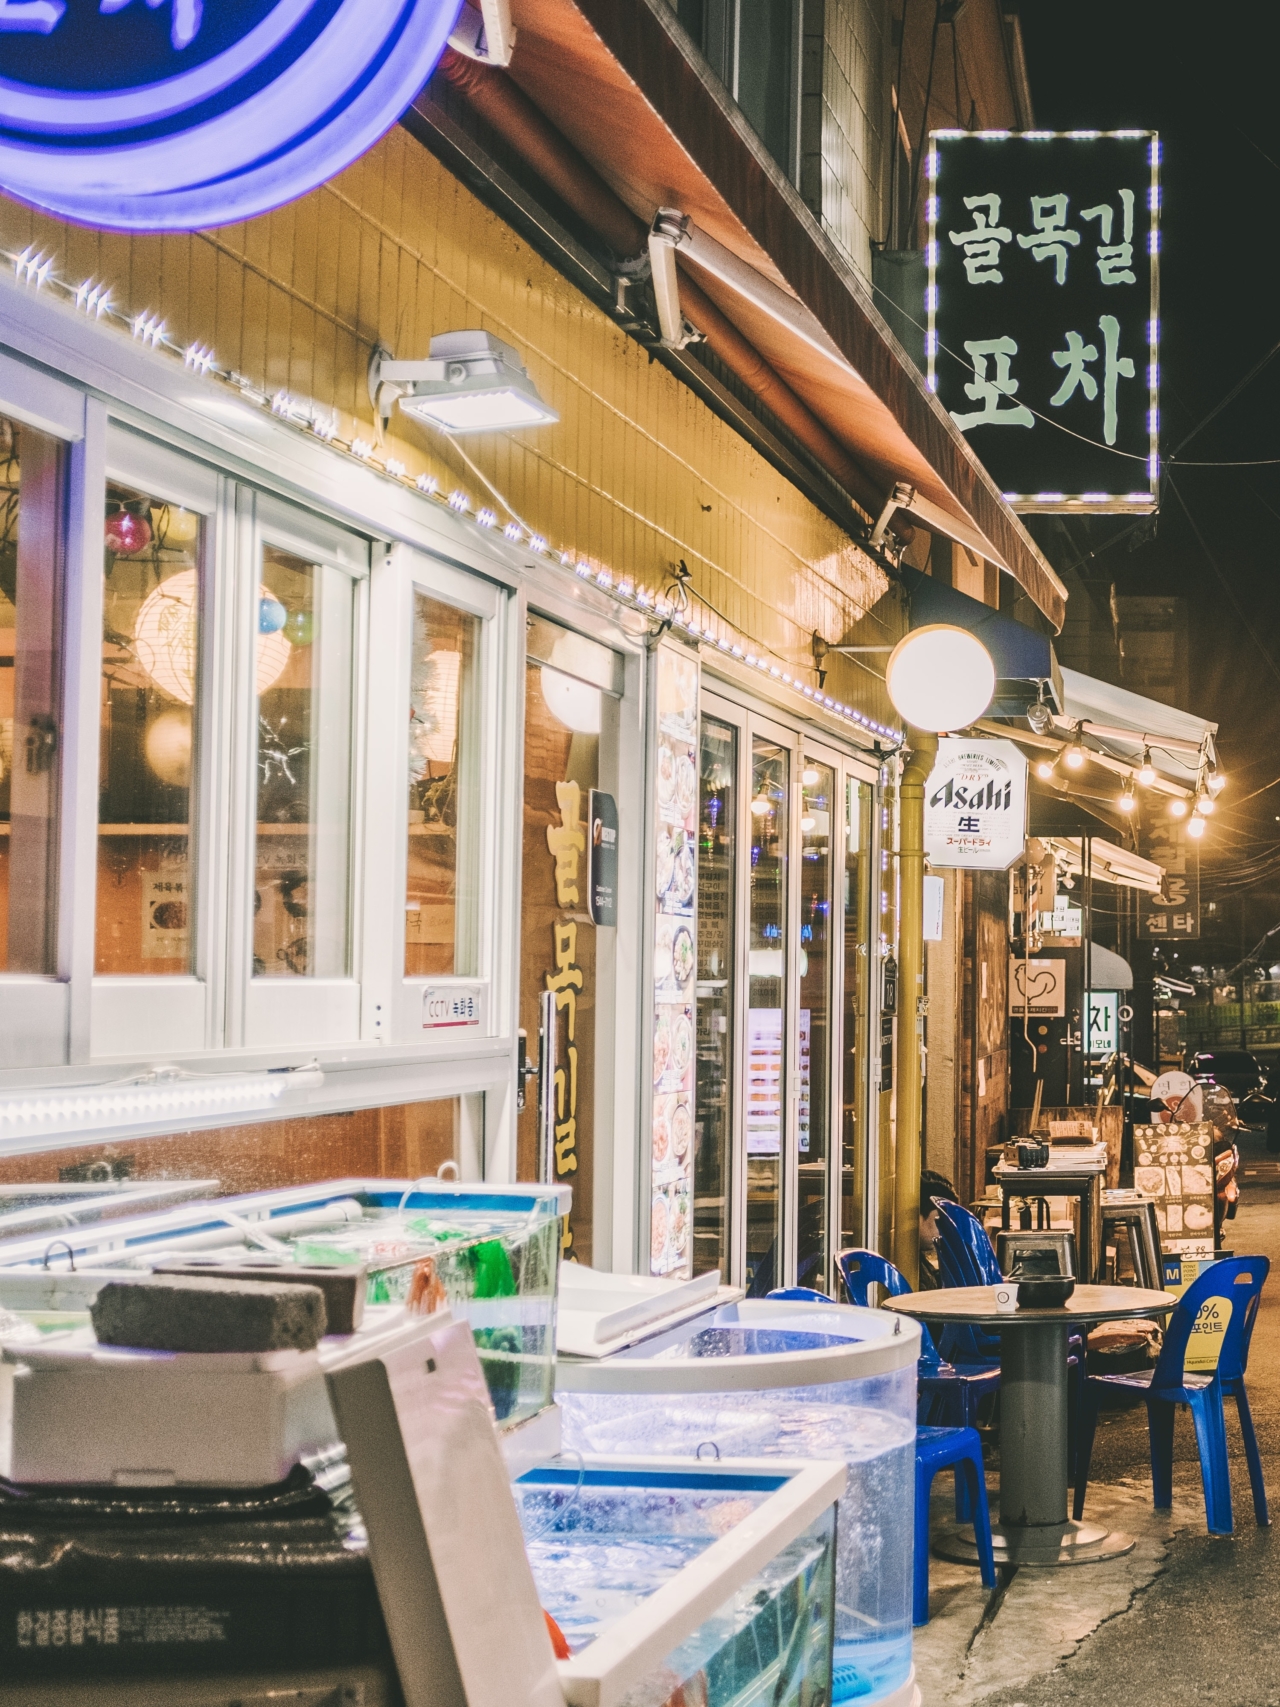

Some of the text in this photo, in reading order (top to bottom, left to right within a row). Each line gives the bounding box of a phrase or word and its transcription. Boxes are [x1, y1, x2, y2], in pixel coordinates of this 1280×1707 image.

[949, 188, 1137, 285] 골목길
[948, 315, 1135, 445] 포차
[930, 777, 1012, 811] Asahi
[958, 815, 980, 833] 生
[946, 837, 992, 847] スーパードライ
[1146, 912, 1194, 932] 센타
[428, 997, 474, 1017] CCTV 녹화중
[1165, 1268, 1180, 1280] M
[1191, 1322, 1223, 1334] 포인트
